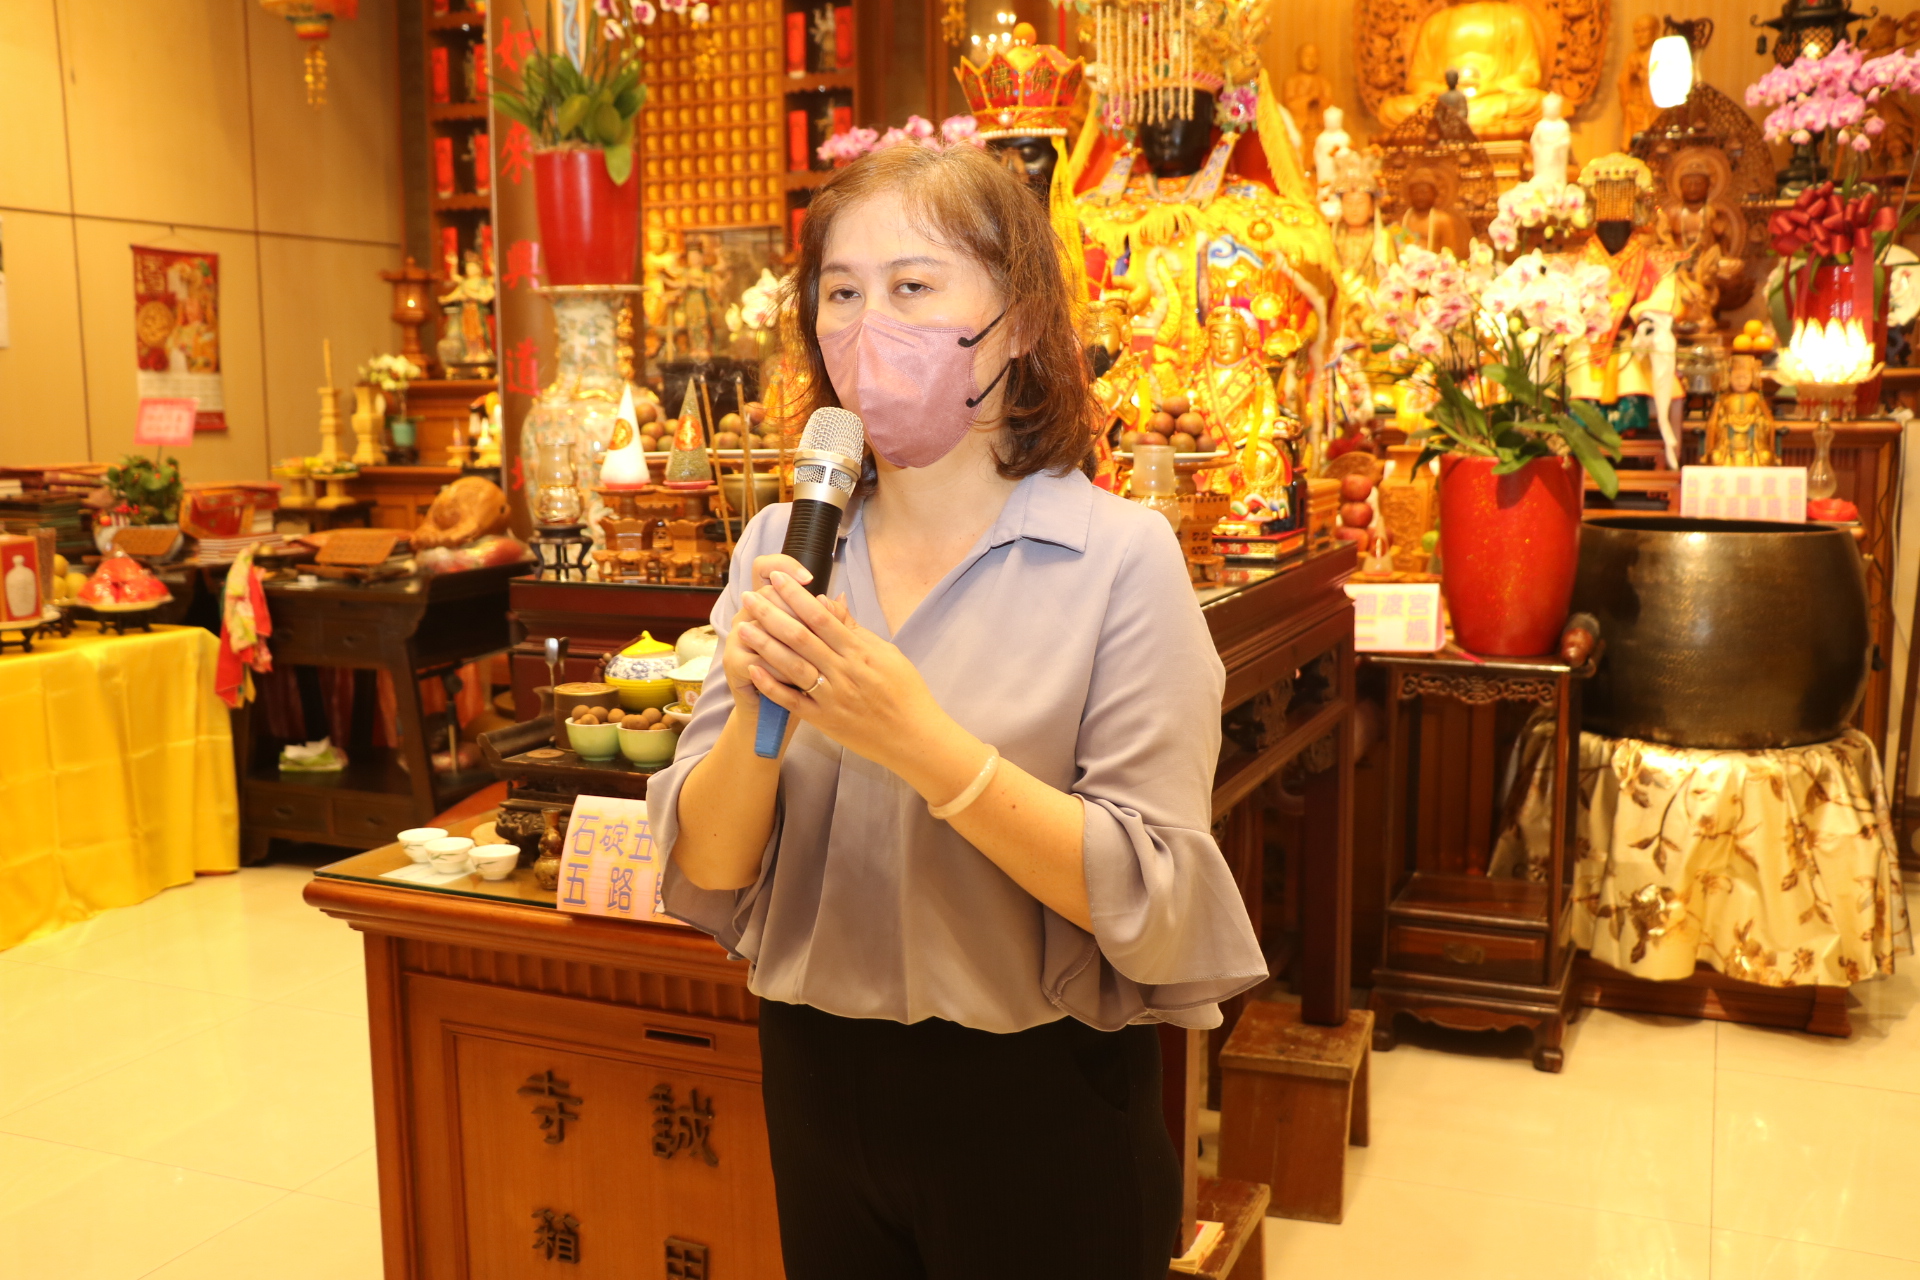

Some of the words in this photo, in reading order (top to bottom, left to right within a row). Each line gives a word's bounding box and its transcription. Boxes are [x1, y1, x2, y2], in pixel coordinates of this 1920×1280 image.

[572, 814, 654, 862] 石碇五
[563, 862, 670, 918] 五路
